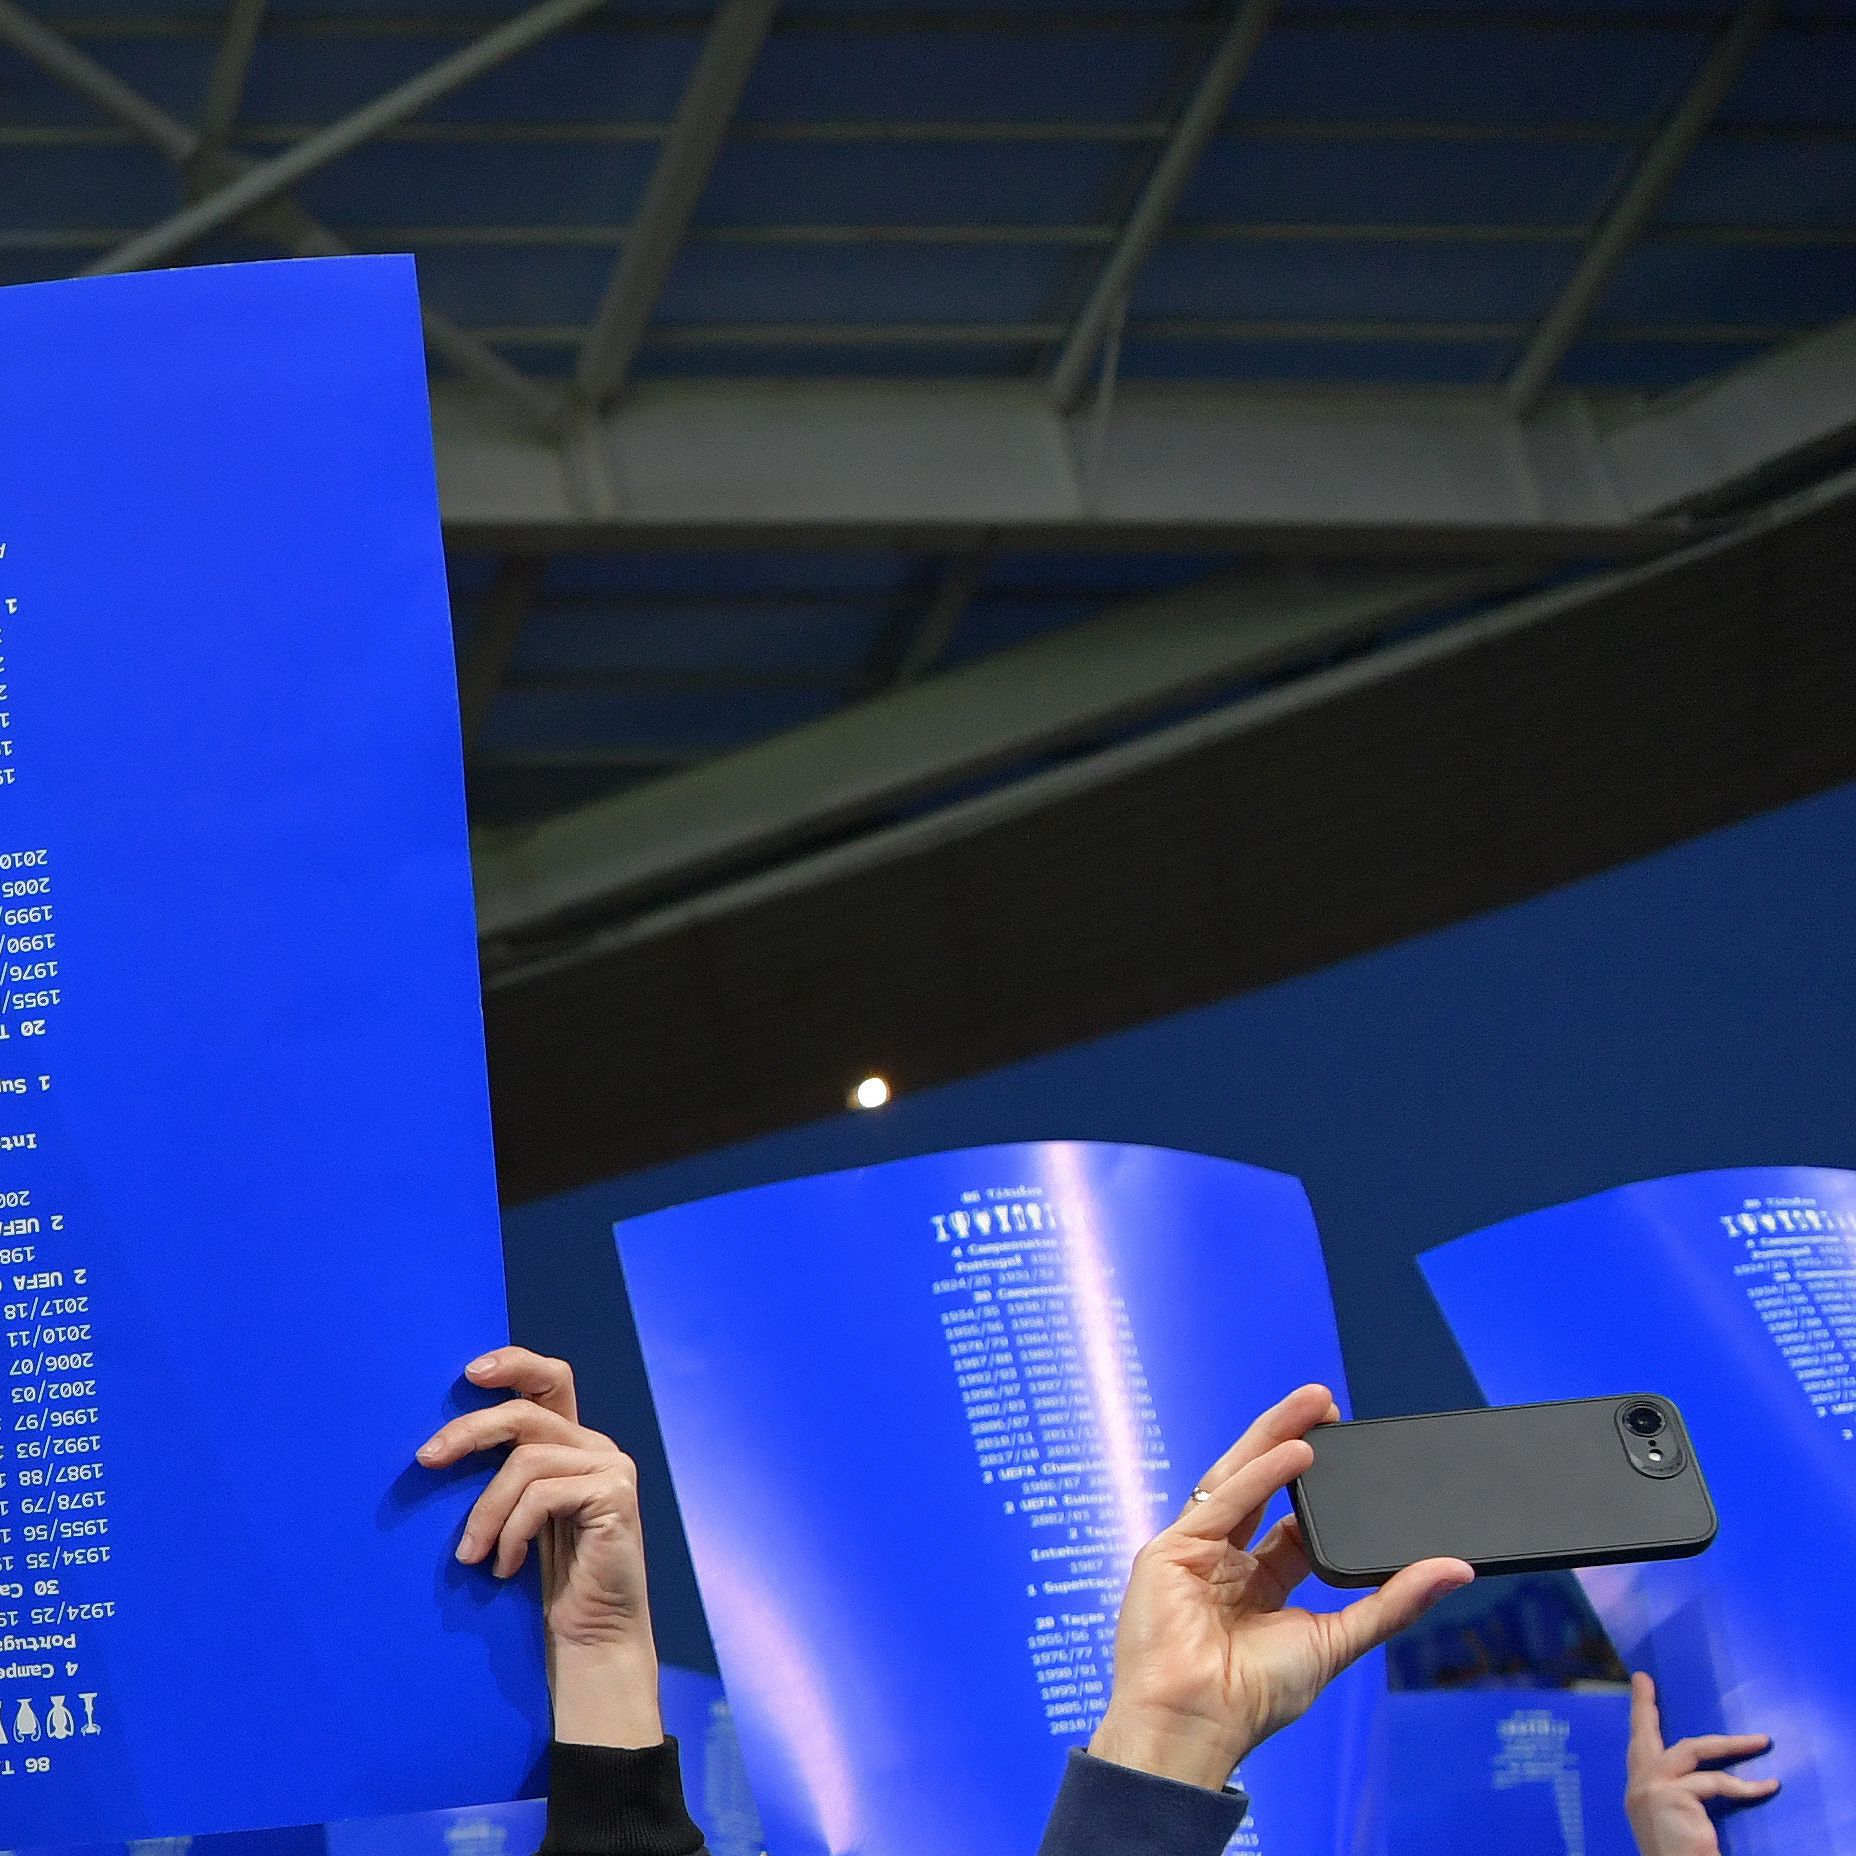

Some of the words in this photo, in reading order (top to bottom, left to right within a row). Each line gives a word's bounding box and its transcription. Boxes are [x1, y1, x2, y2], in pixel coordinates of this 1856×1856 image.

[4, 597, 19, 616] 1
[20, 1019, 47, 1038] 20
[50, 1214, 65, 1232] 2
[3, 1296, 90, 1321] 2017/18
[30, 1600, 117, 1626] 1924/25
[24, 1756, 52, 1774] 86
